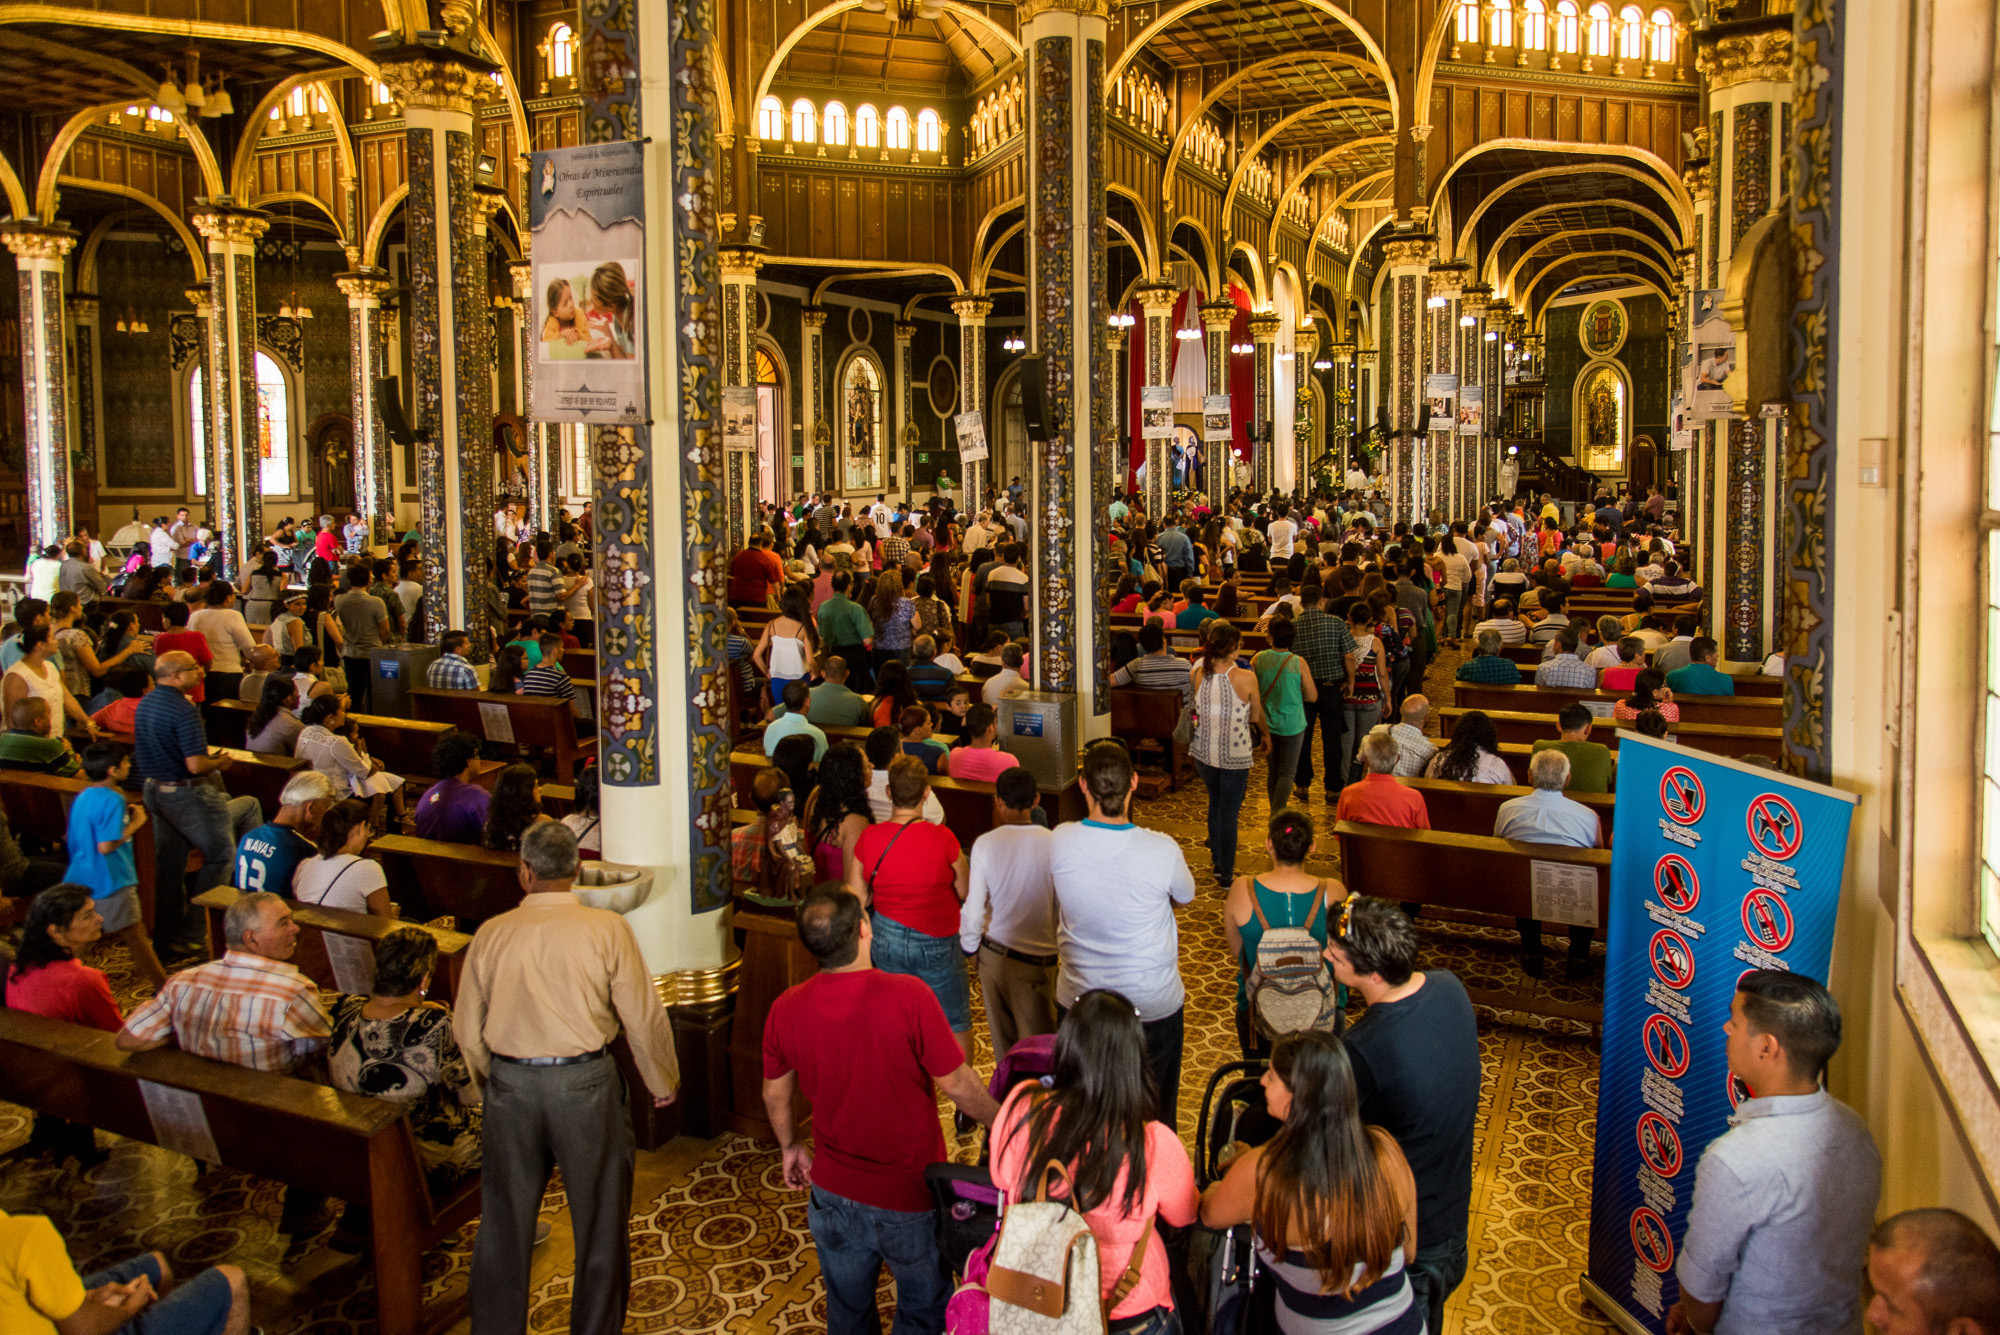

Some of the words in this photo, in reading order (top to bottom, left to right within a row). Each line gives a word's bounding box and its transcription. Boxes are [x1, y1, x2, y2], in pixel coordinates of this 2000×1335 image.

[559, 170, 580, 182] Obras
[582, 168, 591, 180] de
[593, 163, 643, 179] Misericordia
[576, 184, 624, 201] Espirituales
[875, 513, 885, 525] 10
[1659, 818, 1670, 831] No
[1663, 829, 1674, 840] No
[243, 837, 277, 859] NAVAS
[1747, 851, 1761, 864] No
[1741, 859, 1759, 874] Con
[239, 854, 267, 893] 13
[1753, 873, 1766, 886] No
[1739, 941, 1752, 953] No
[1734, 947, 1747, 961] No
